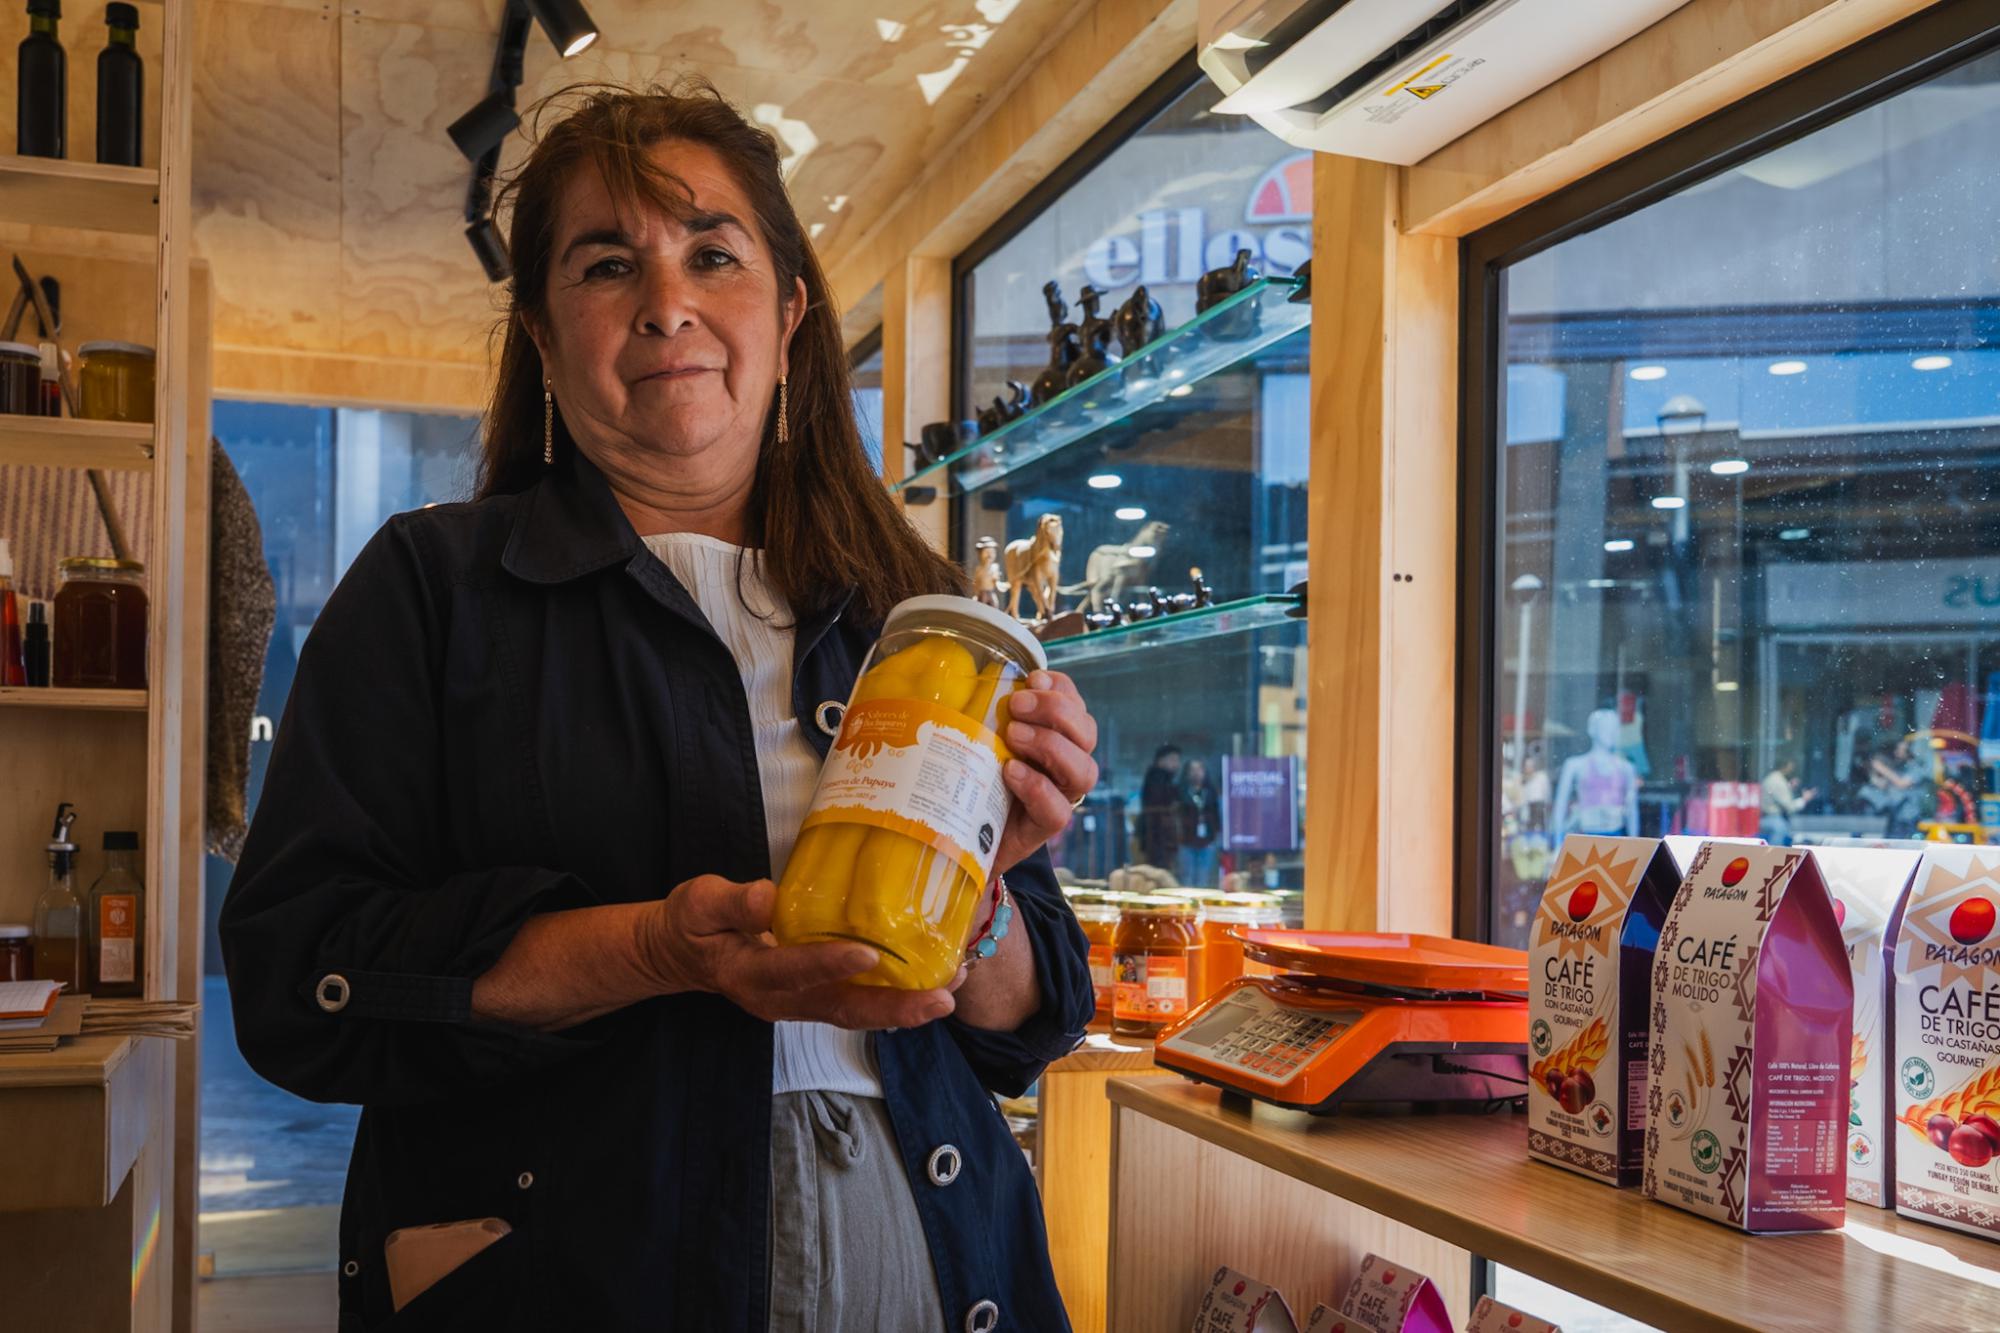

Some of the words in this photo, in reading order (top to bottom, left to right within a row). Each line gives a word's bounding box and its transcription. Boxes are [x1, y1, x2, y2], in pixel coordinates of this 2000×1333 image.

[850, 776, 860, 785] de
[861, 775, 897, 788] Papaya
[1703, 887, 1748, 902] PATAGOM
[1550, 921, 1601, 942] PATAGOM
[1677, 934, 1738, 970] CAFÉ
[1545, 956, 1594, 989] CAFÉ
[1673, 966, 1689, 982] DE
[1692, 969, 1730, 989] TRIGO
[1545, 982, 1558, 998] DE
[1561, 985, 1594, 1004] TRIGO
[1672, 983, 1719, 1003] MOLIDO
[1919, 984, 2000, 1022] CAFÉ
[1545, 999, 1559, 1010] CON
[1559, 1001, 1593, 1017] CASTAÑAS
[1553, 1014, 1584, 1029] GOURMET
[1921, 1015, 1941, 1032] DE
[1946, 1018, 2000, 1040] TRIGO
[1922, 1033, 1943, 1046] CON
[1946, 1037, 2000, 1055] CASTAÑAS
[1937, 1052, 1986, 1069] GOURMET
[1928, 1170, 1948, 1183] YUNGAY
[1949, 1175, 1970, 1187] REGIÓN
[1971, 1181, 1978, 1189] DE
[1969, 1170, 1991, 1181] GRAMOS
[1953, 1184, 1970, 1196] CHILE
[1360, 1293, 1387, 1315] CAFÉ
[1210, 1307, 1234, 1329] CAFÉ
[1357, 1306, 1381, 1328] TRIGO
